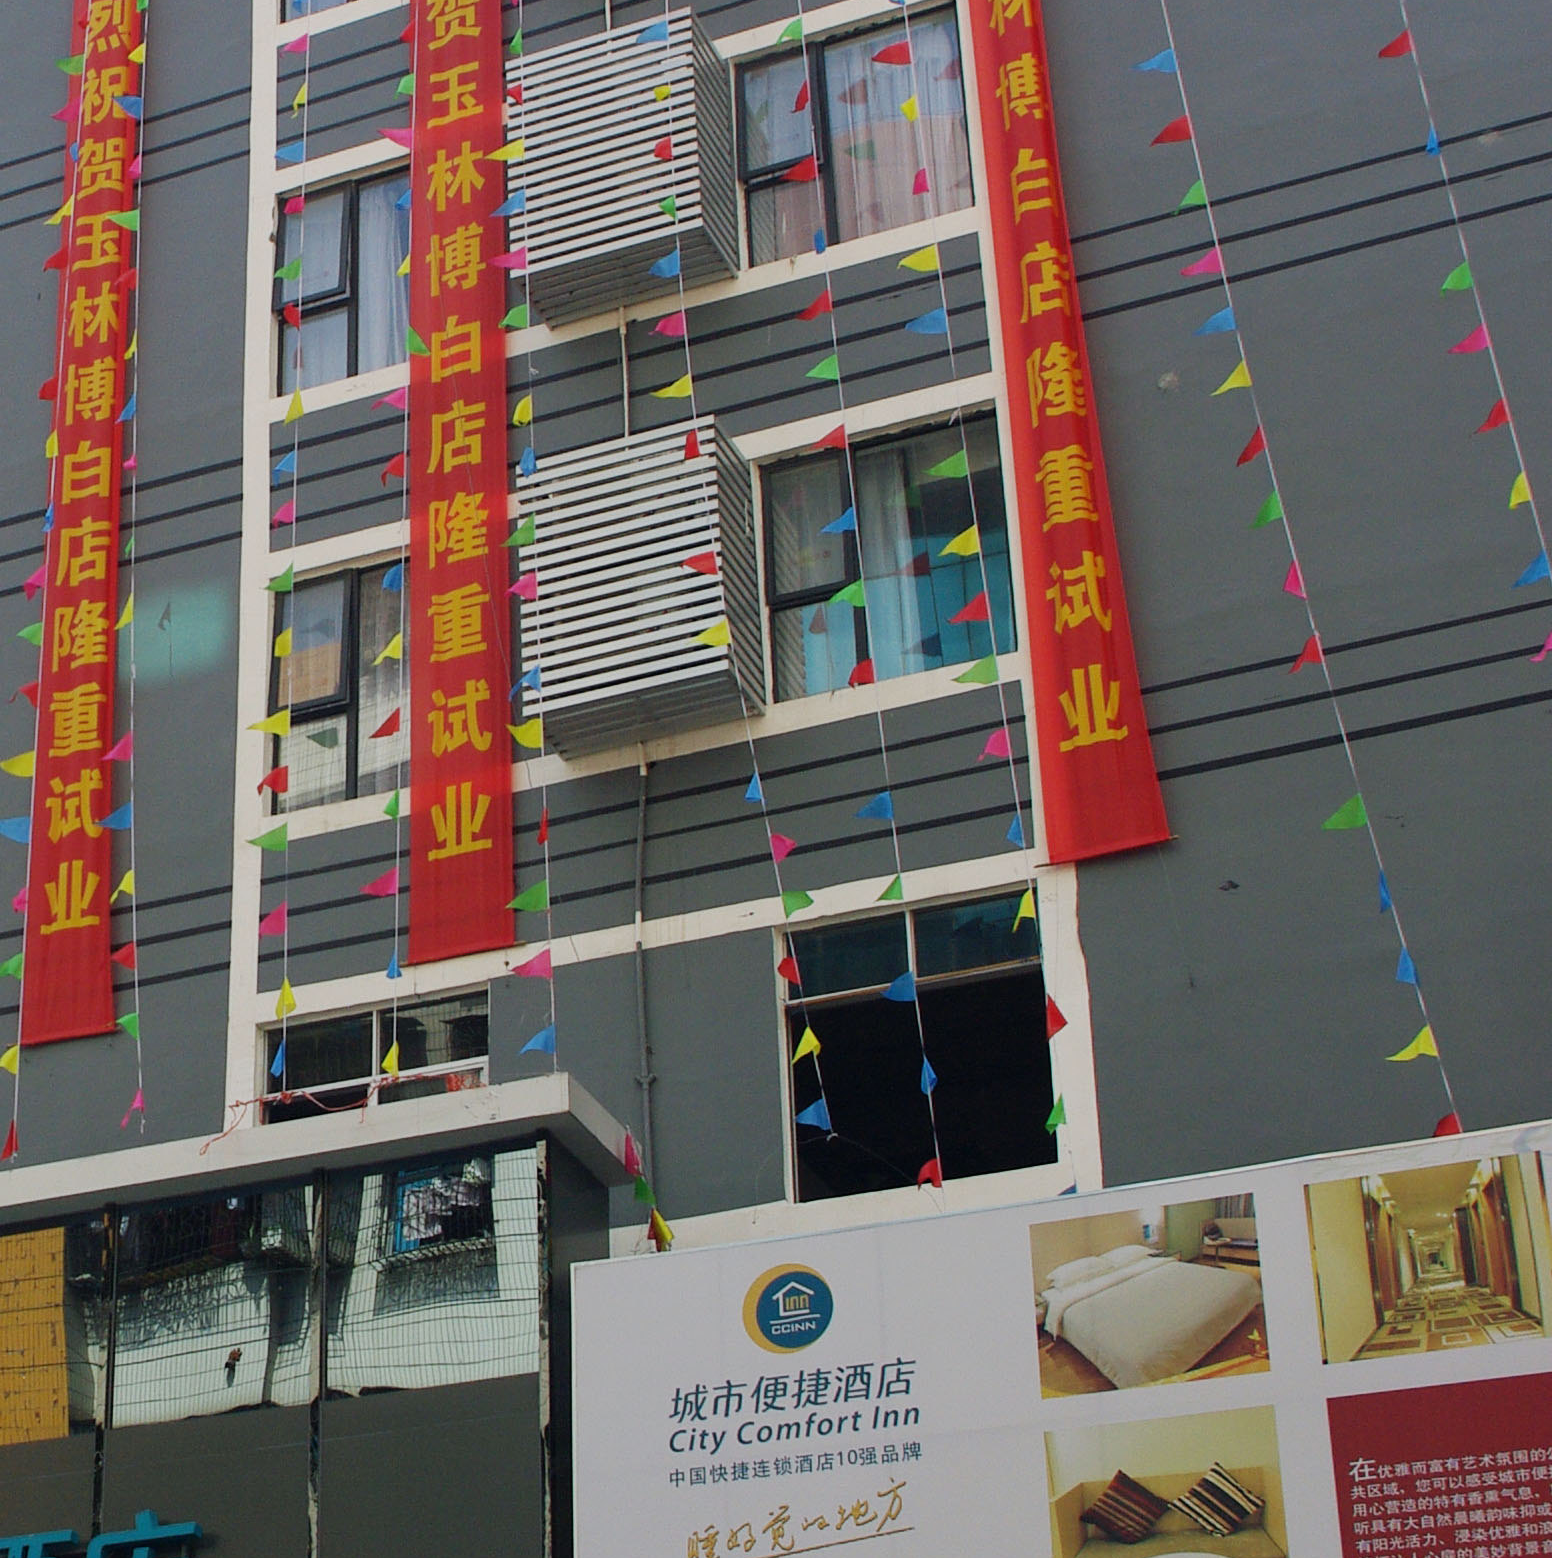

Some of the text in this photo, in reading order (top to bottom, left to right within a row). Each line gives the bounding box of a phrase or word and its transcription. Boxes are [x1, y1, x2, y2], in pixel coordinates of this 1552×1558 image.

[771, 1319, 817, 1335] CCINN
[669, 1357, 917, 1424] 城市便捷酒店
[669, 1404, 920, 1455] City Comfort Inn
[669, 1441, 923, 1489] 中国快捷连锁酒店10强品牌
